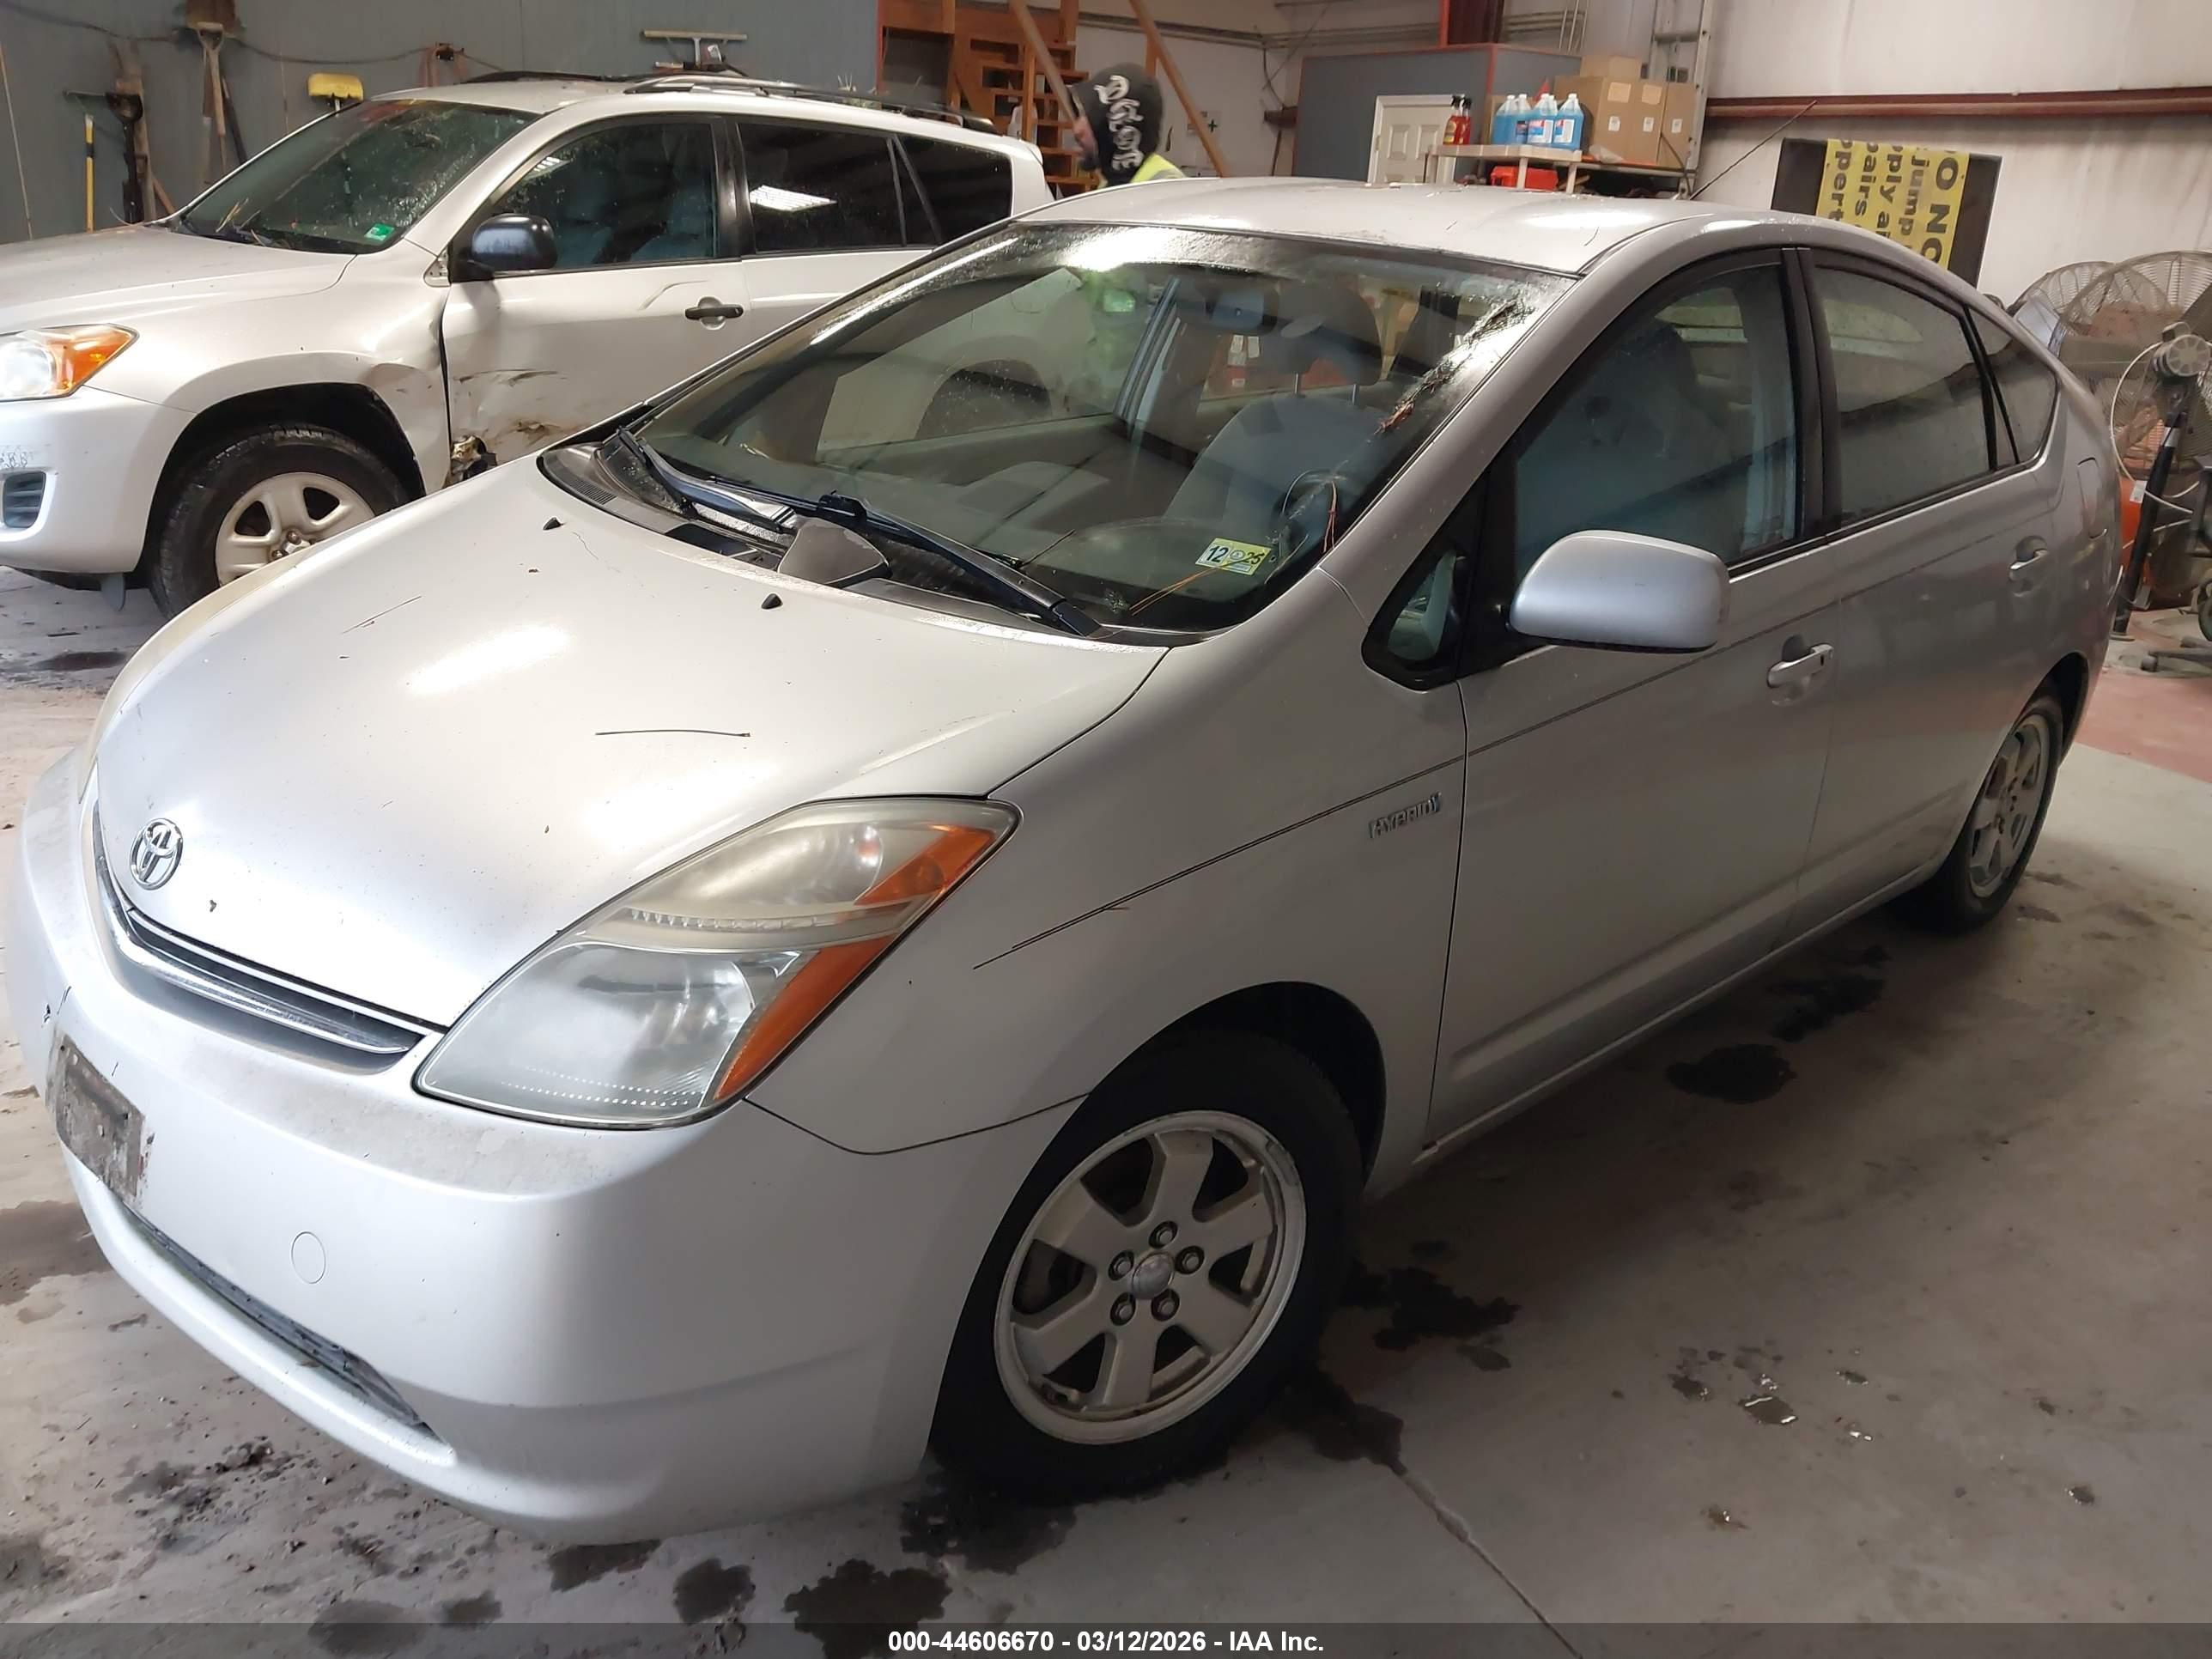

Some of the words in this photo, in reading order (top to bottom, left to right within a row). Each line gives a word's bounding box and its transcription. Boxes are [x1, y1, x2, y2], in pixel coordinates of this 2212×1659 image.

[1936, 149, 1960, 191] O
[1899, 155, 1930, 235] jump
[1206, 545, 1230, 563] 12
[1243, 551, 1266, 565] 25
